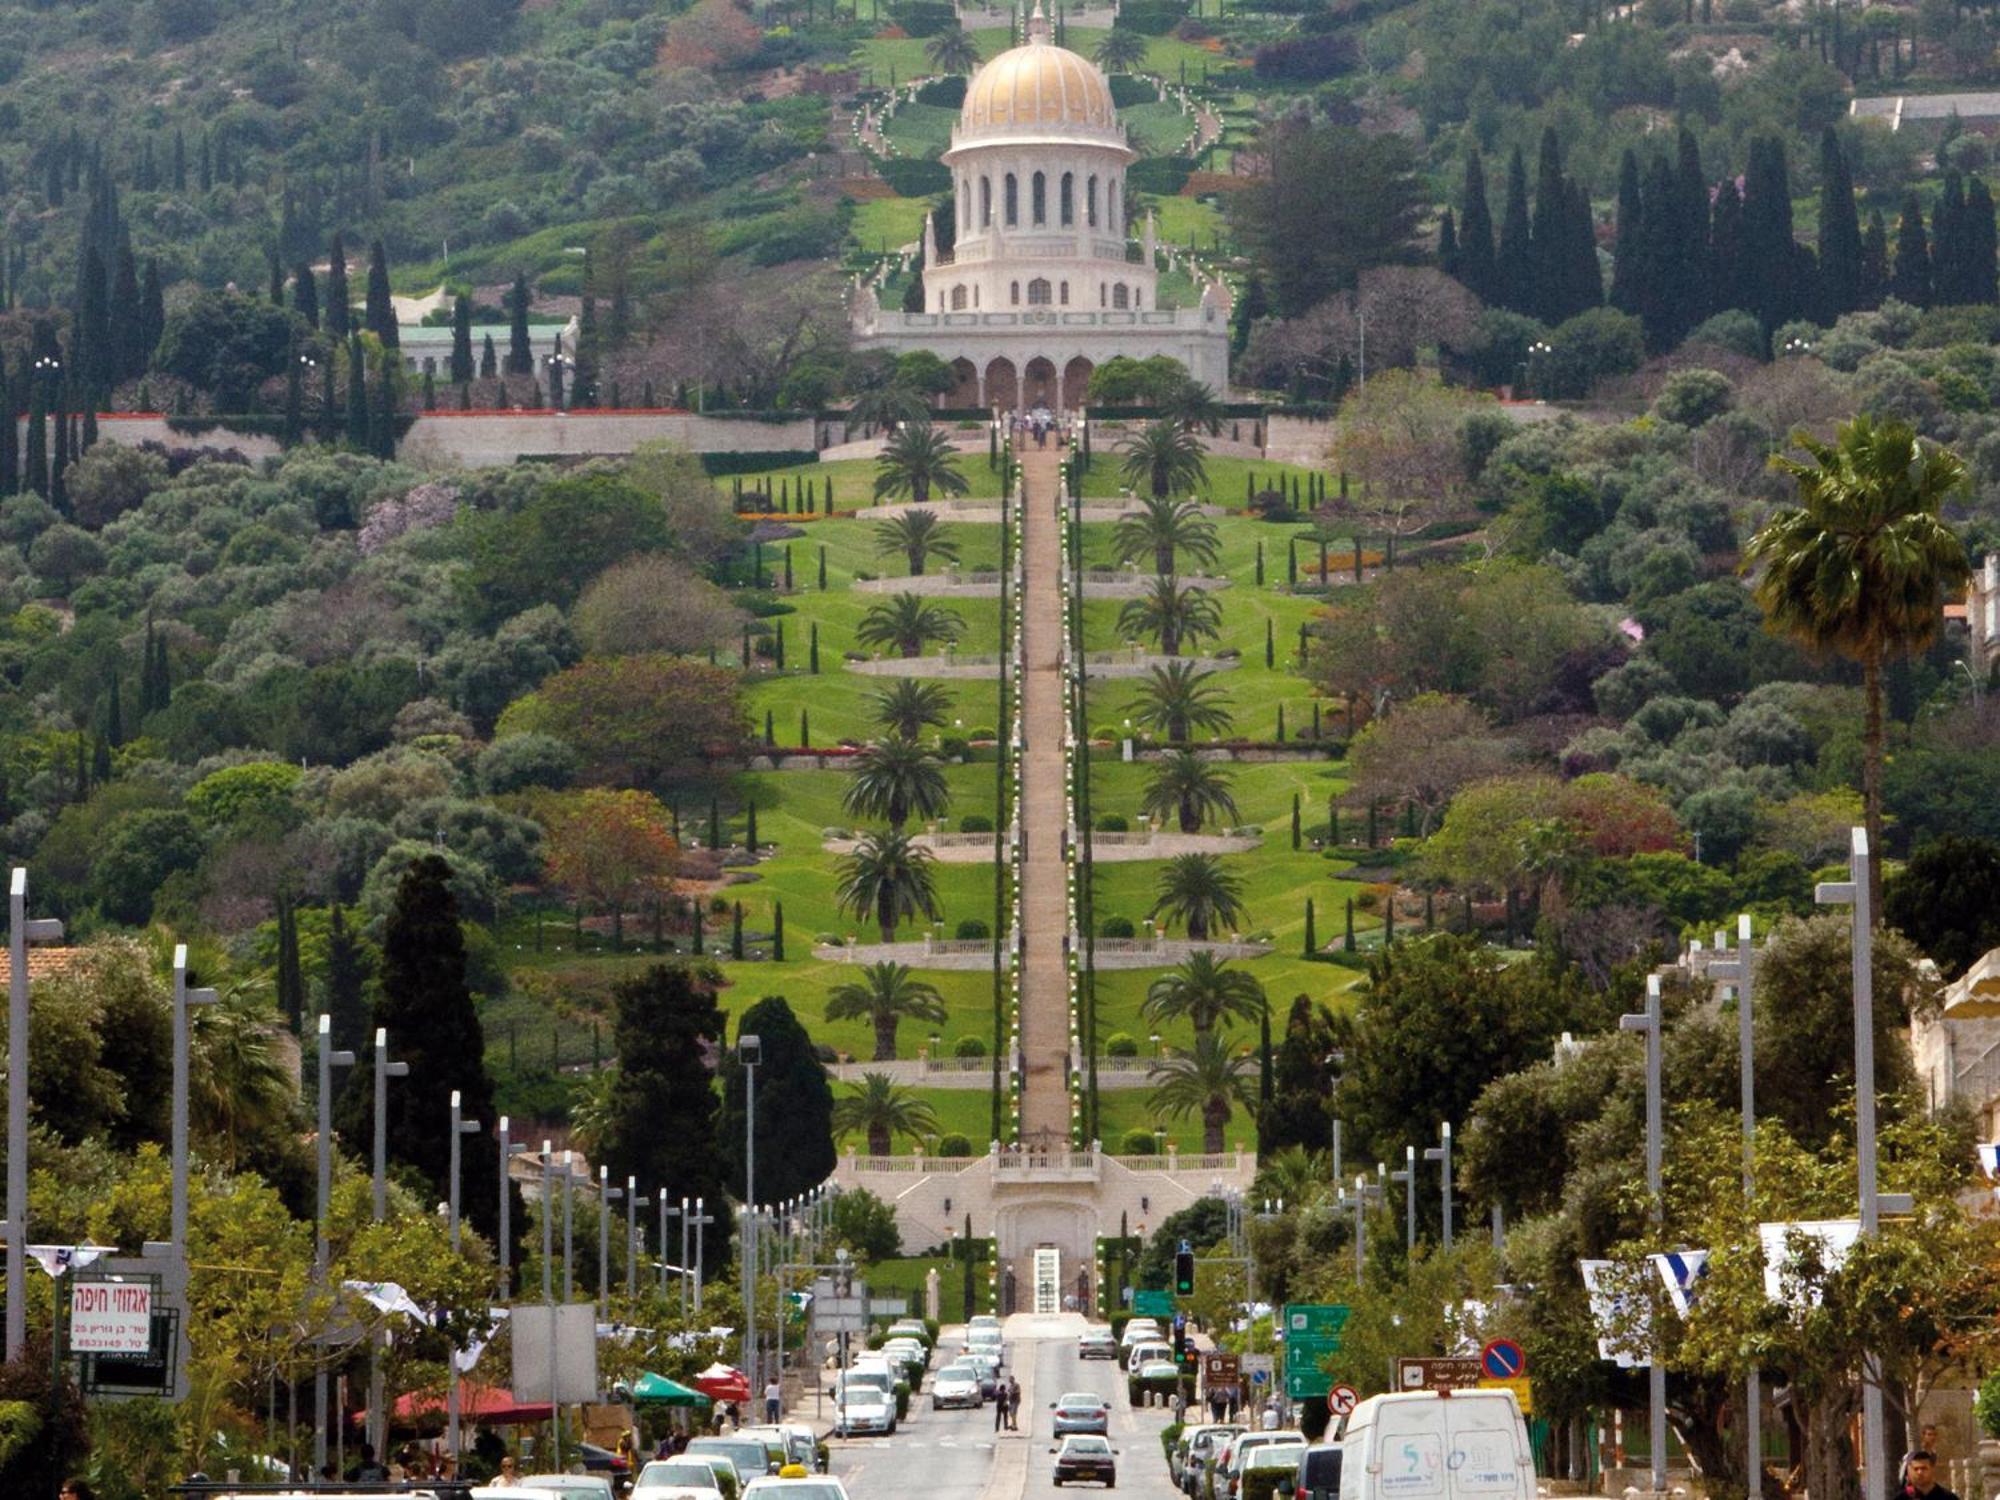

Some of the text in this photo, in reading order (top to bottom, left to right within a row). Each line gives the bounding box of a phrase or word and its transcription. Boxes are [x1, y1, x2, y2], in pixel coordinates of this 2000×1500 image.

[75, 1288, 149, 1313] אגזוזי חיפה
[90, 1324, 113, 1334] גוריון
[116, 1325, 126, 1335] בן
[1431, 1361, 1454, 1370] חיפה
